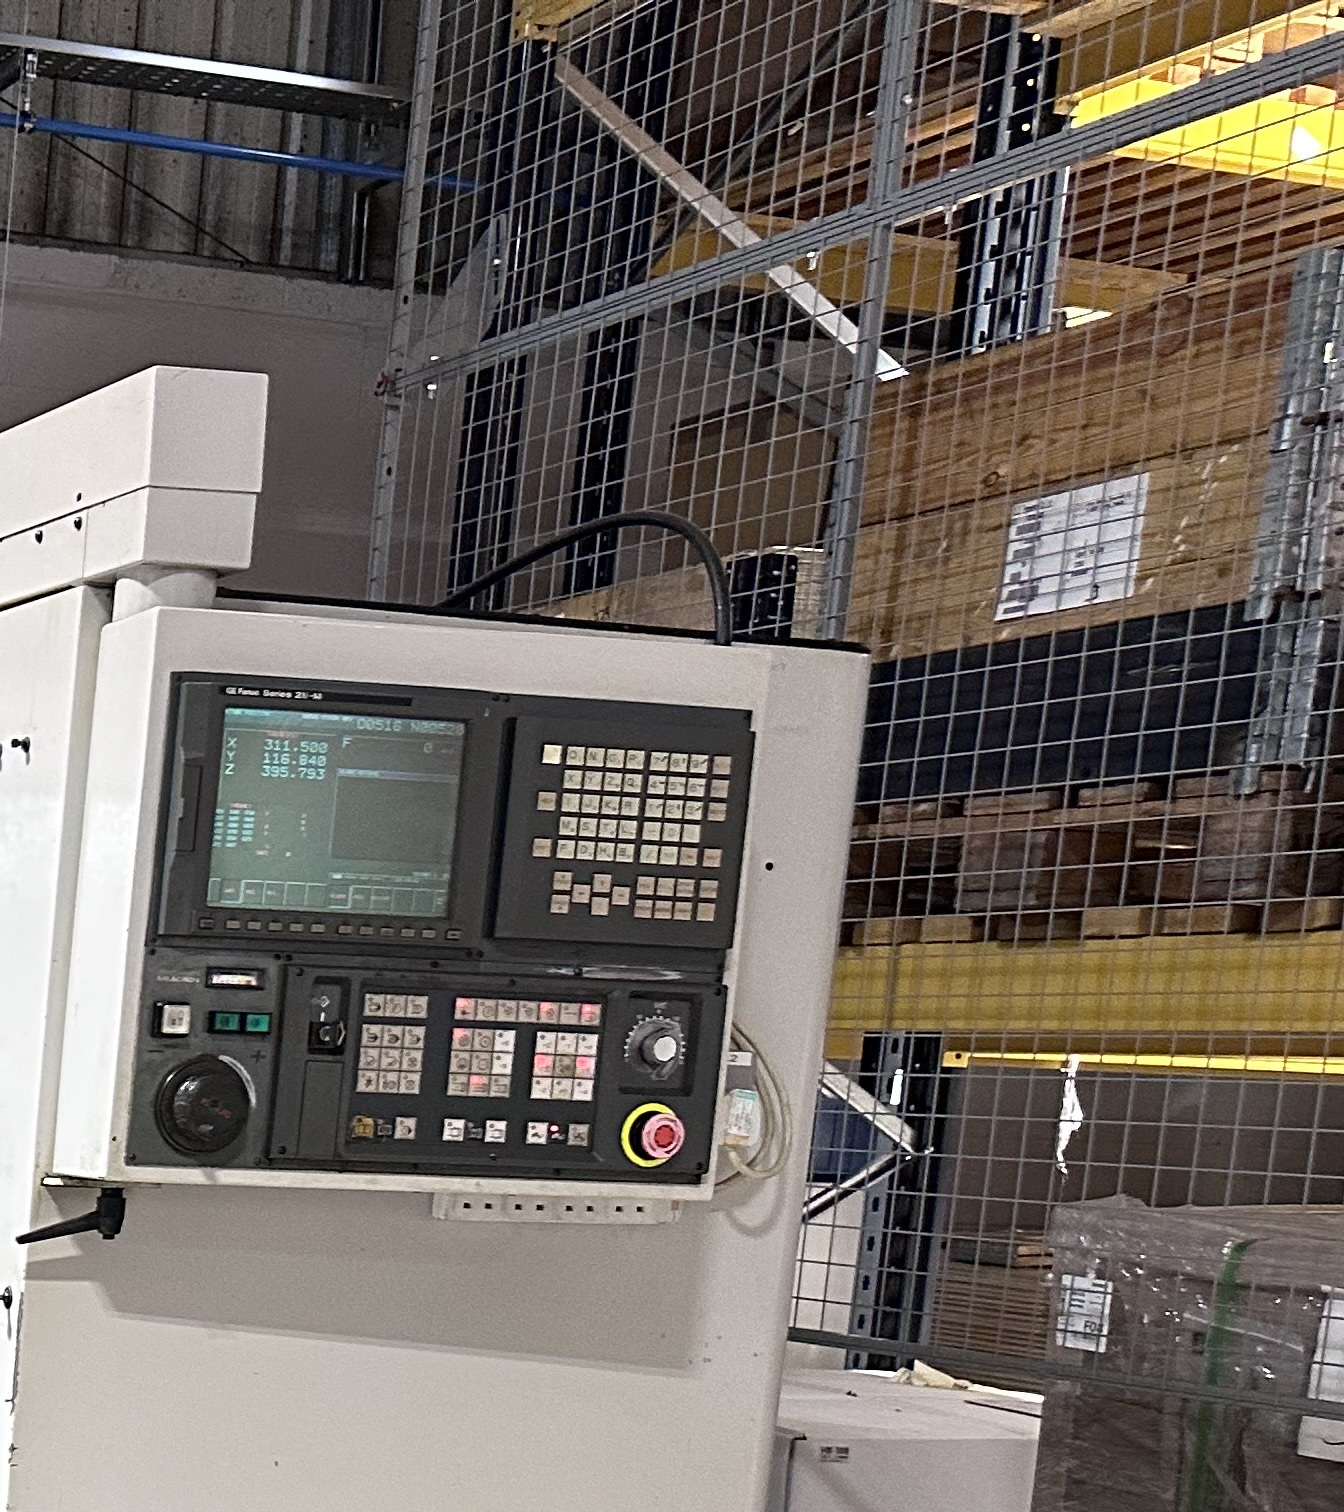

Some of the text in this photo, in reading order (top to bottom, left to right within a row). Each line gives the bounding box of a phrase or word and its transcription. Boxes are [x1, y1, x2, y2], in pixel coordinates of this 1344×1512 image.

[226, 737, 238, 749] X
[342, 736, 352, 749] F
[226, 751, 327, 766] Y 116.840
[224, 763, 235, 774] Z
[260, 765, 326, 780] 395.793
